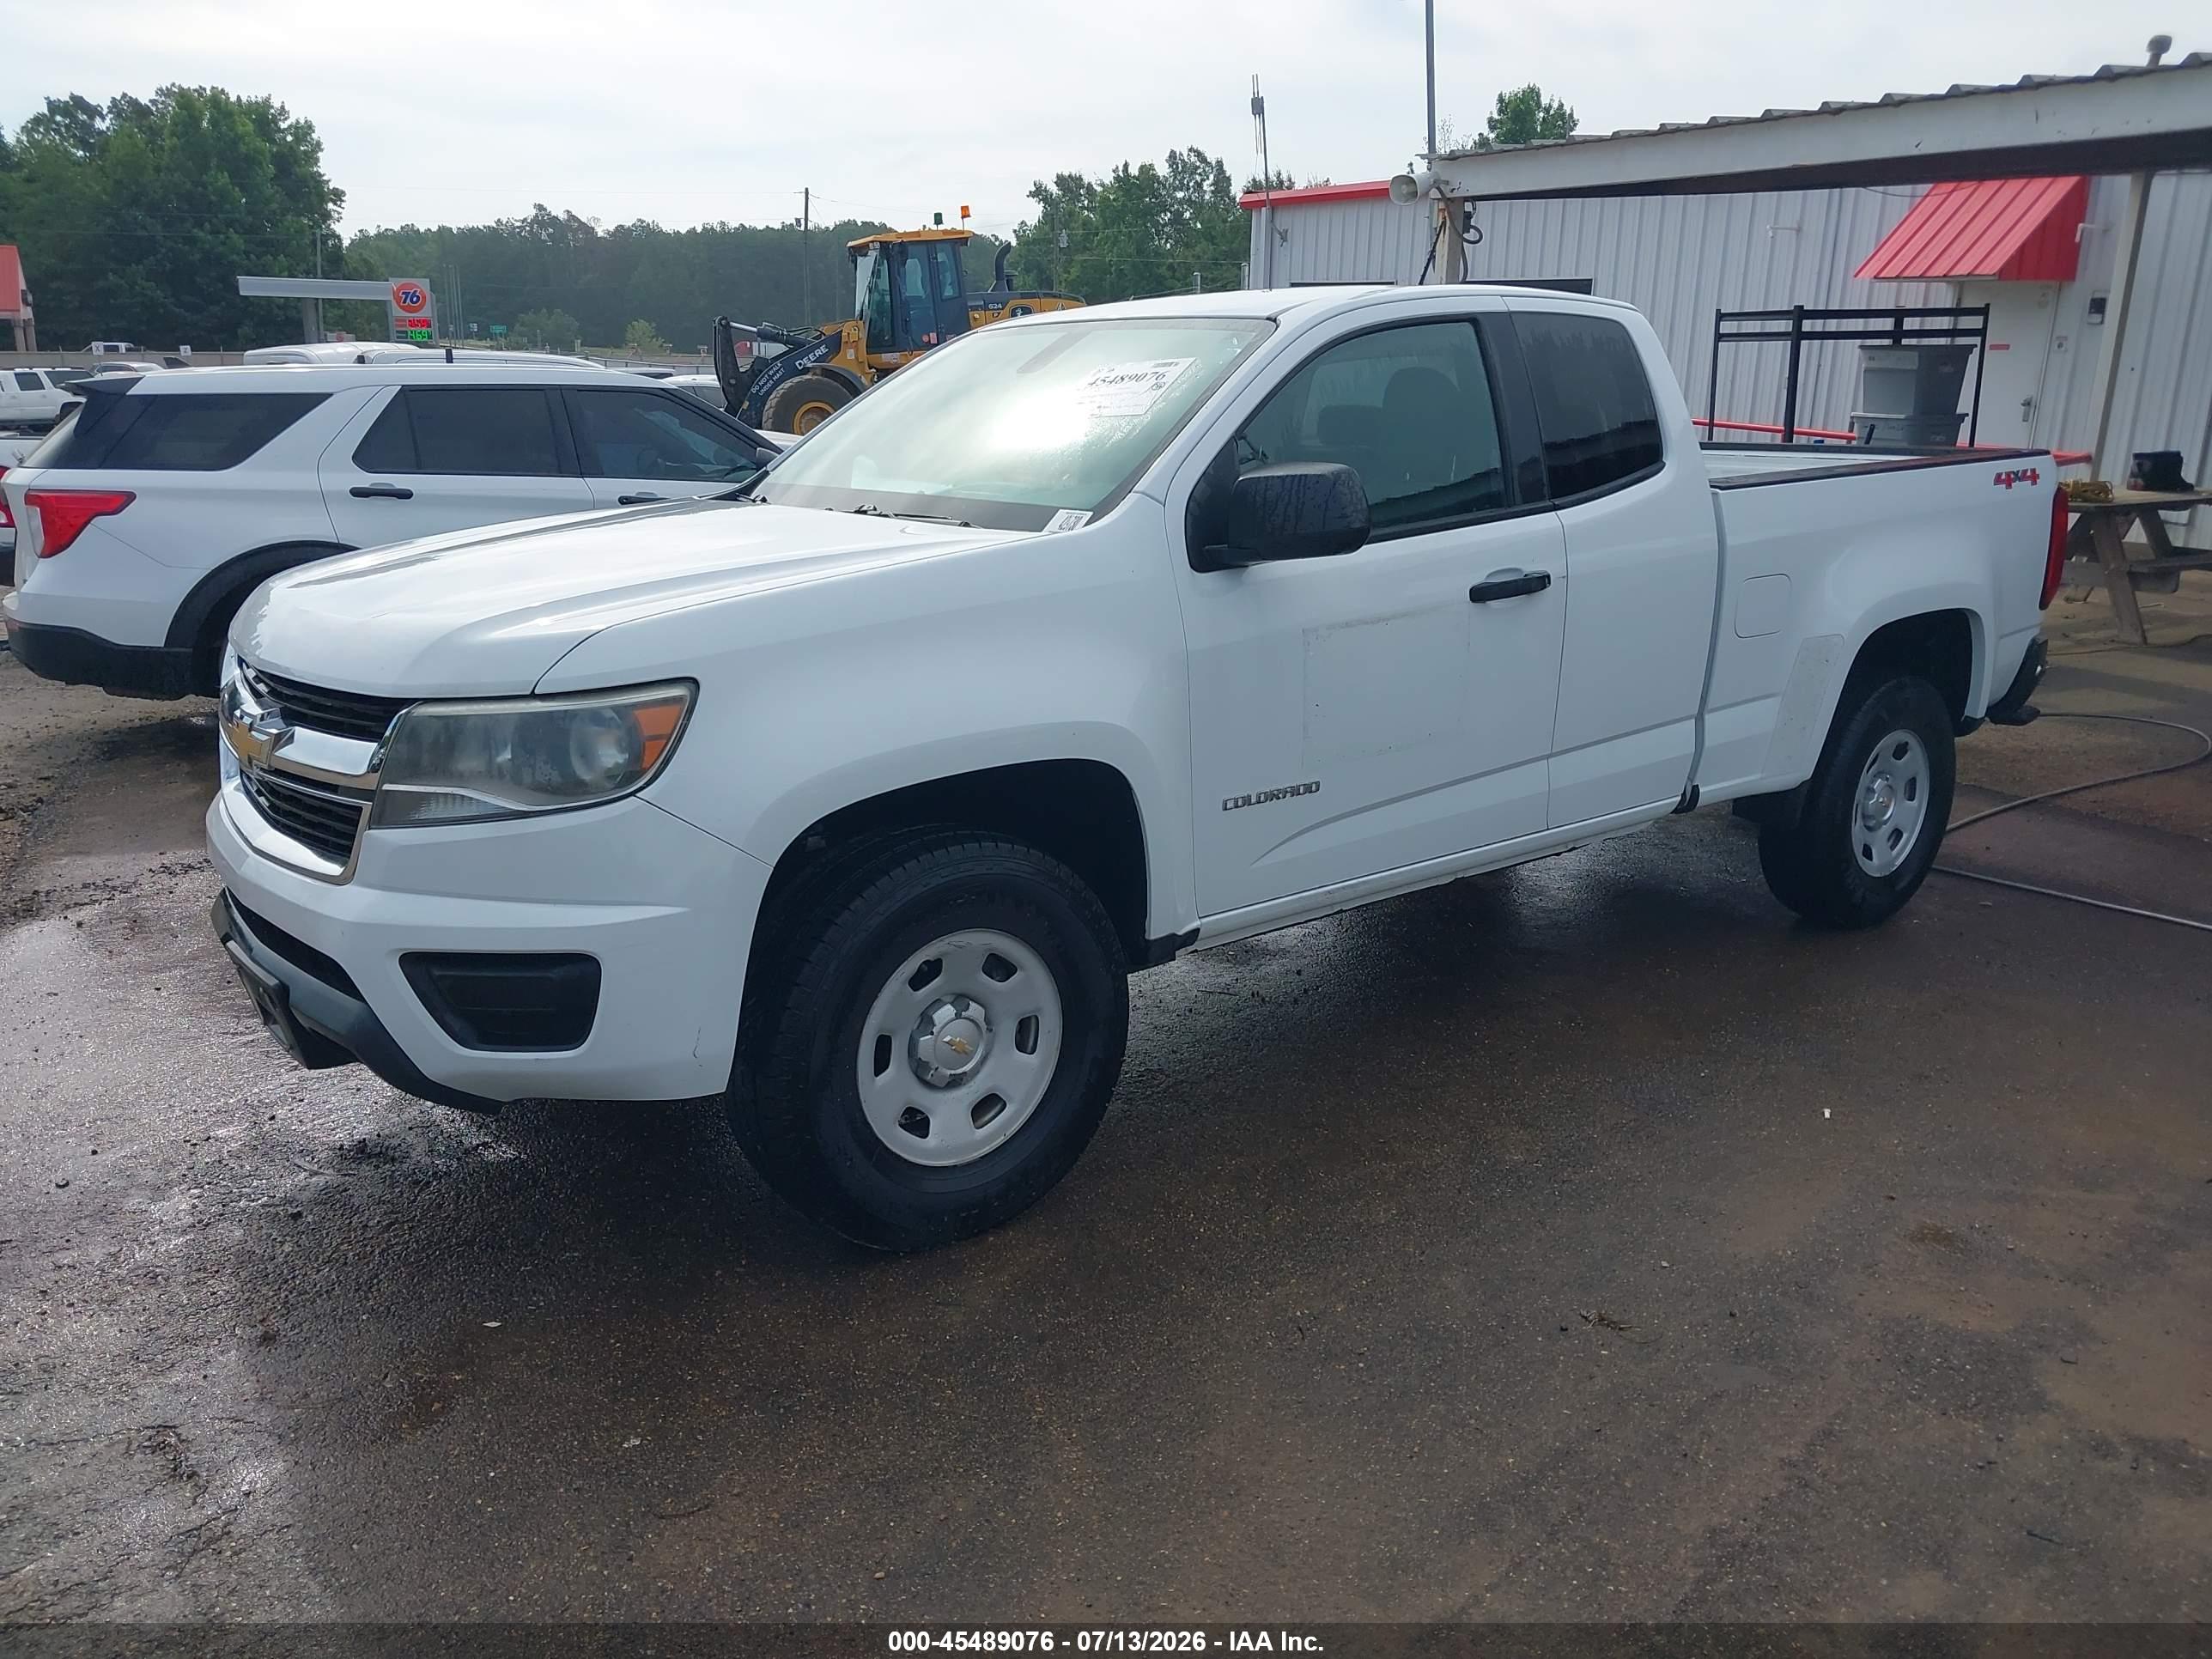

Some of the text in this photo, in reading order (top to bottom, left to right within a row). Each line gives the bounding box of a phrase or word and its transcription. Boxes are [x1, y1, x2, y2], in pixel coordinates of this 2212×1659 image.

[399, 289, 422, 307] 76
[794, 343, 830, 370] DEERE
[750, 362, 782, 394] DO NOT WALK
[757, 368, 786, 397] UNDER MAST
[1087, 370, 1170, 386] 45489076
[1222, 781, 1321, 811] COLORADO
